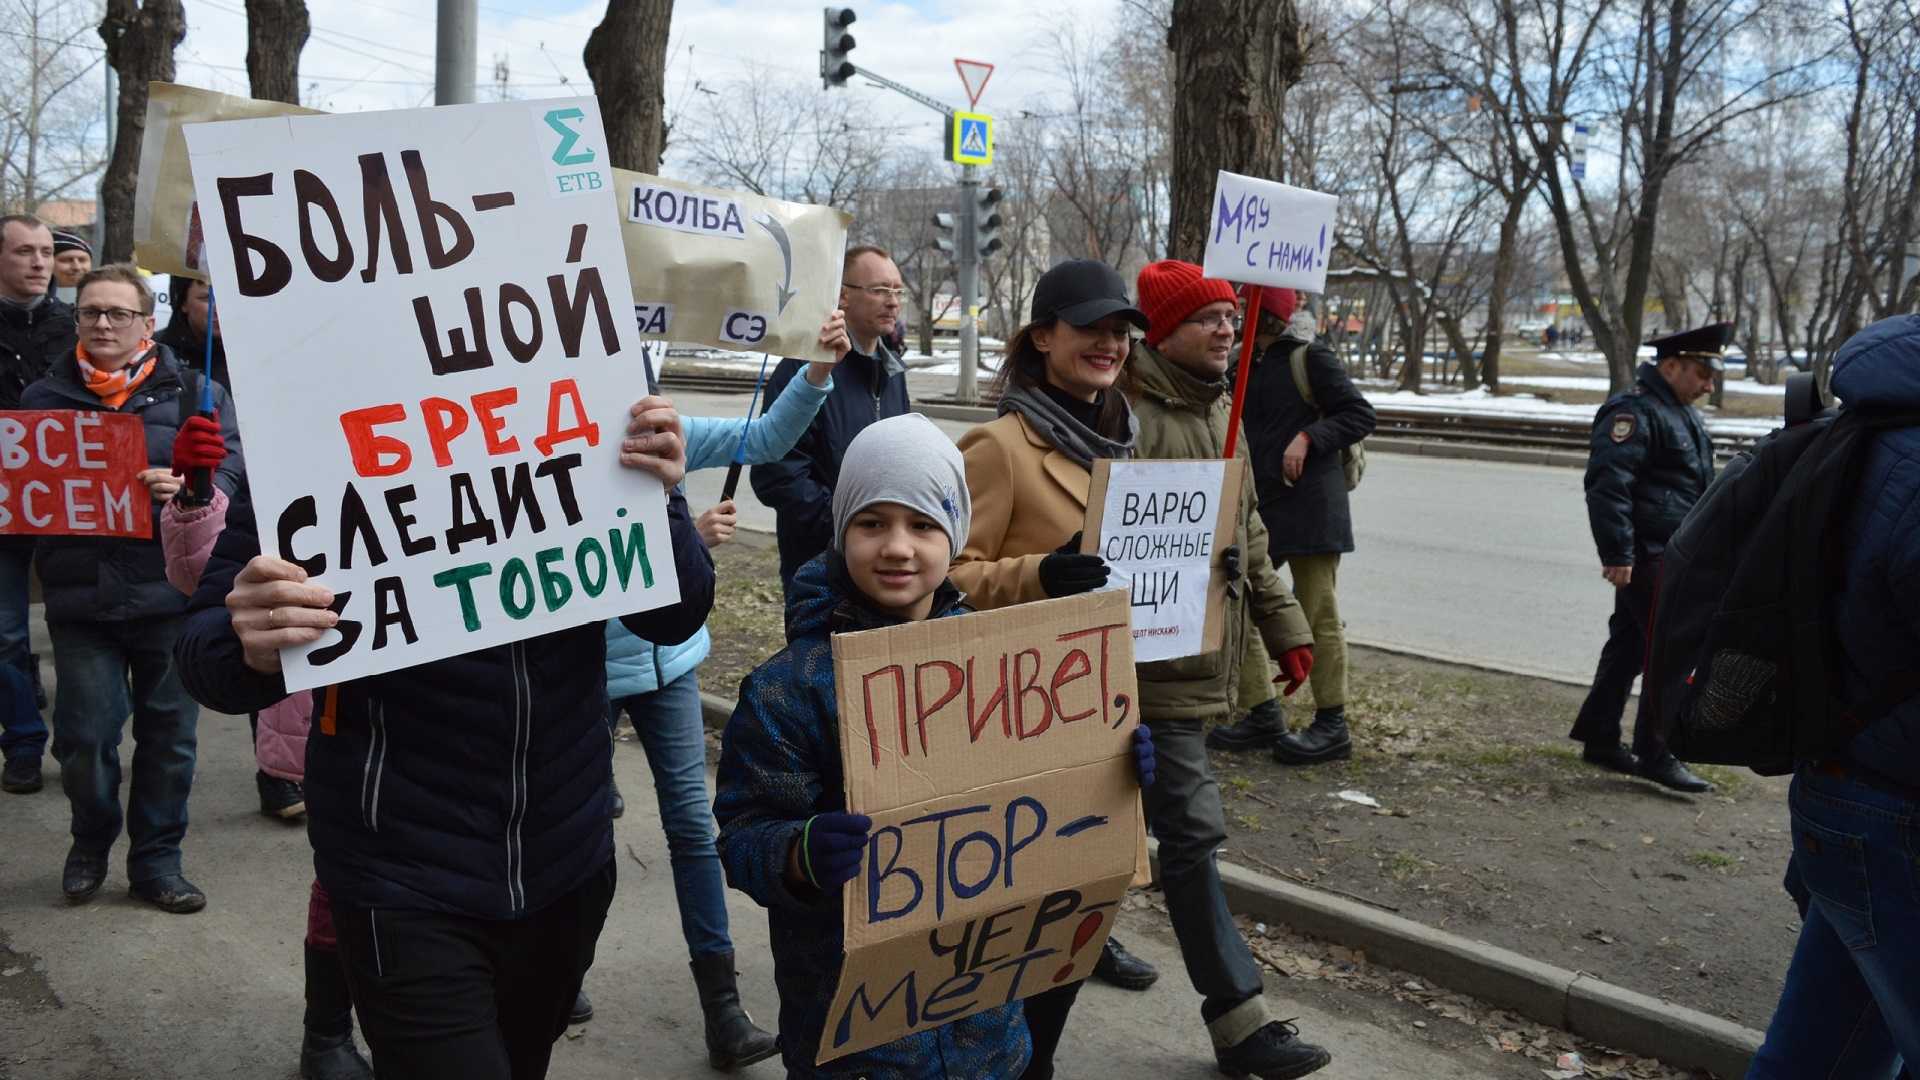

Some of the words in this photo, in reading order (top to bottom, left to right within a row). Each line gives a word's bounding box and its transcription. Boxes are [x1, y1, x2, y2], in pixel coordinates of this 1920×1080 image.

[217, 150, 515, 297] БОЛЬ-
[634, 187, 745, 233] КОЛБА
[412, 224, 621, 375] ШОЙ
[726, 312, 767, 342] СЭ
[0, 411, 108, 470] ВСЁ
[340, 379, 600, 477] БРЕД
[277, 453, 583, 577] СЛЕДИТ
[1106, 532, 1212, 561] СЛОЖНЫЕ
[1122, 491, 1207, 526] ВАРЮ
[307, 576, 419, 666] ЗА
[433, 507, 654, 632] ТОБОЙ
[1130, 571, 1179, 614] ЩИ
[868, 795, 1108, 923] ВТОР-
[929, 889, 1118, 976] ЧЕР-
